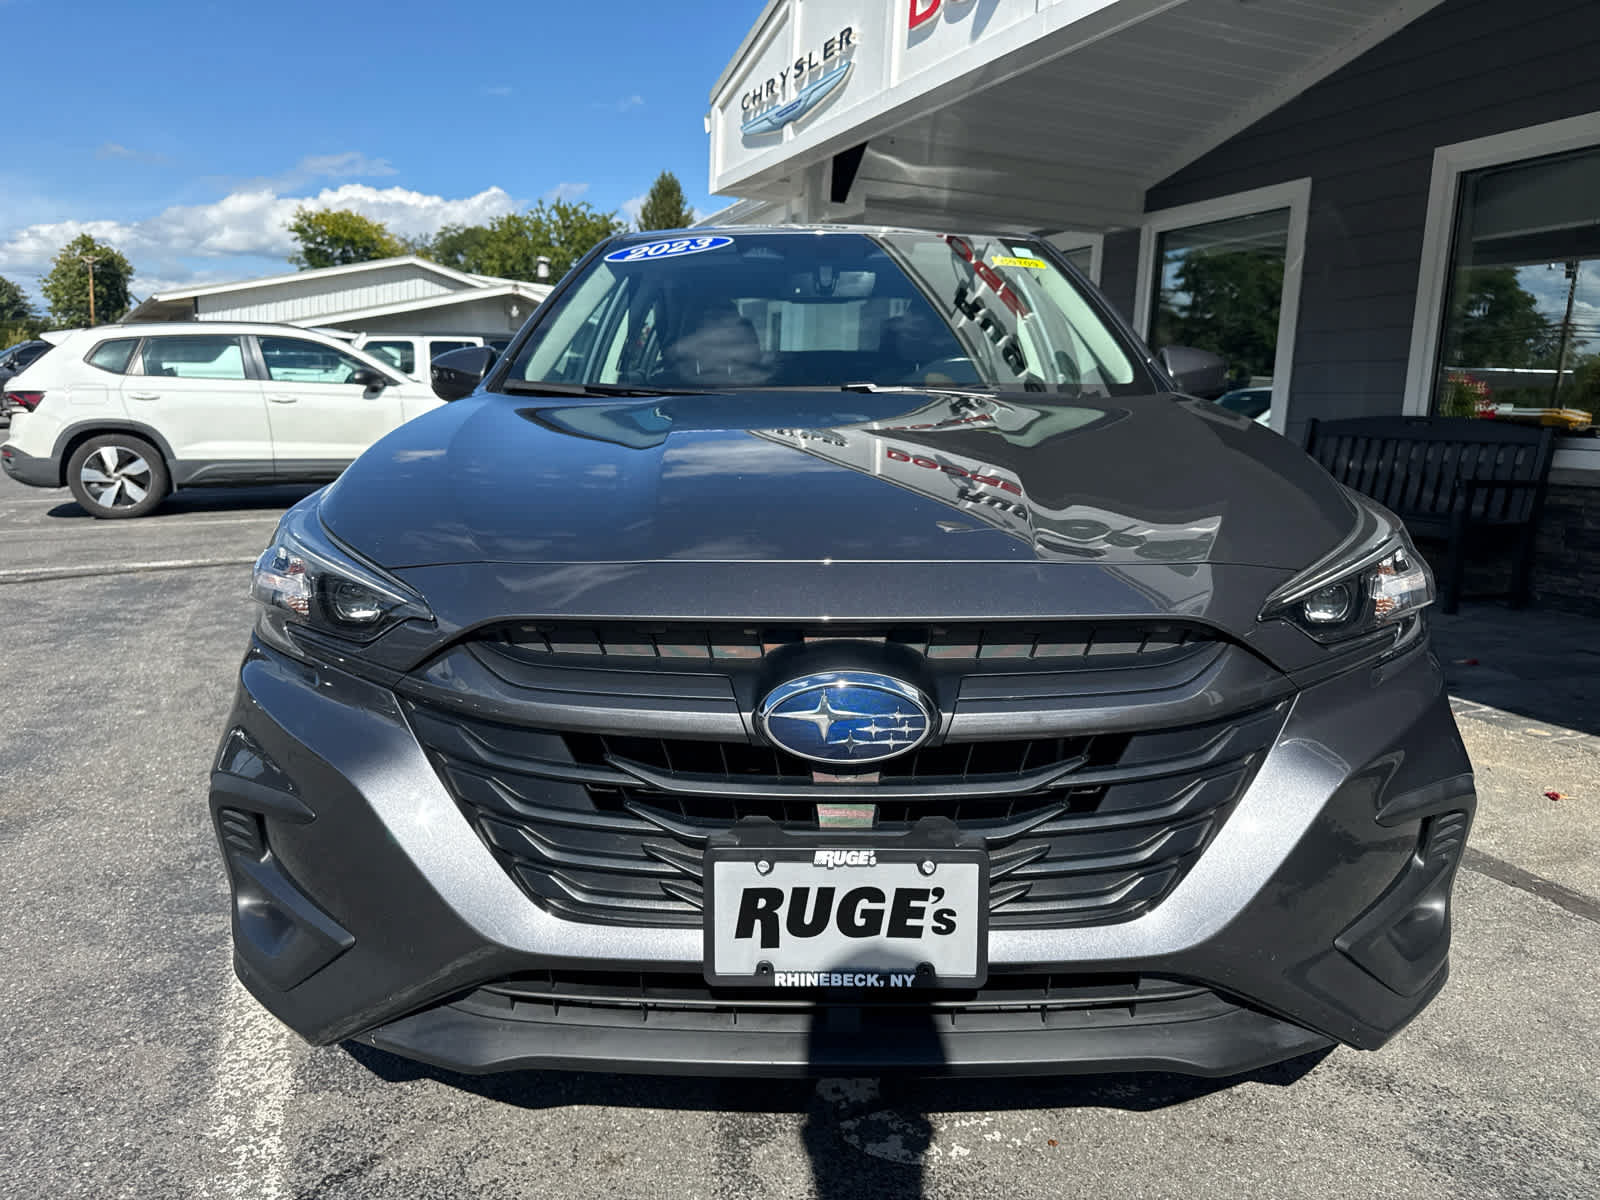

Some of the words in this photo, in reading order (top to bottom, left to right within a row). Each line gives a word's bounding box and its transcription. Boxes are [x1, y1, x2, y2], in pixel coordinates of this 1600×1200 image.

[741, 26, 853, 111] CHRYSLER
[624, 238, 713, 261] 2023
[774, 972, 885, 987] RHINEBECK,
[890, 974, 915, 987] NY
